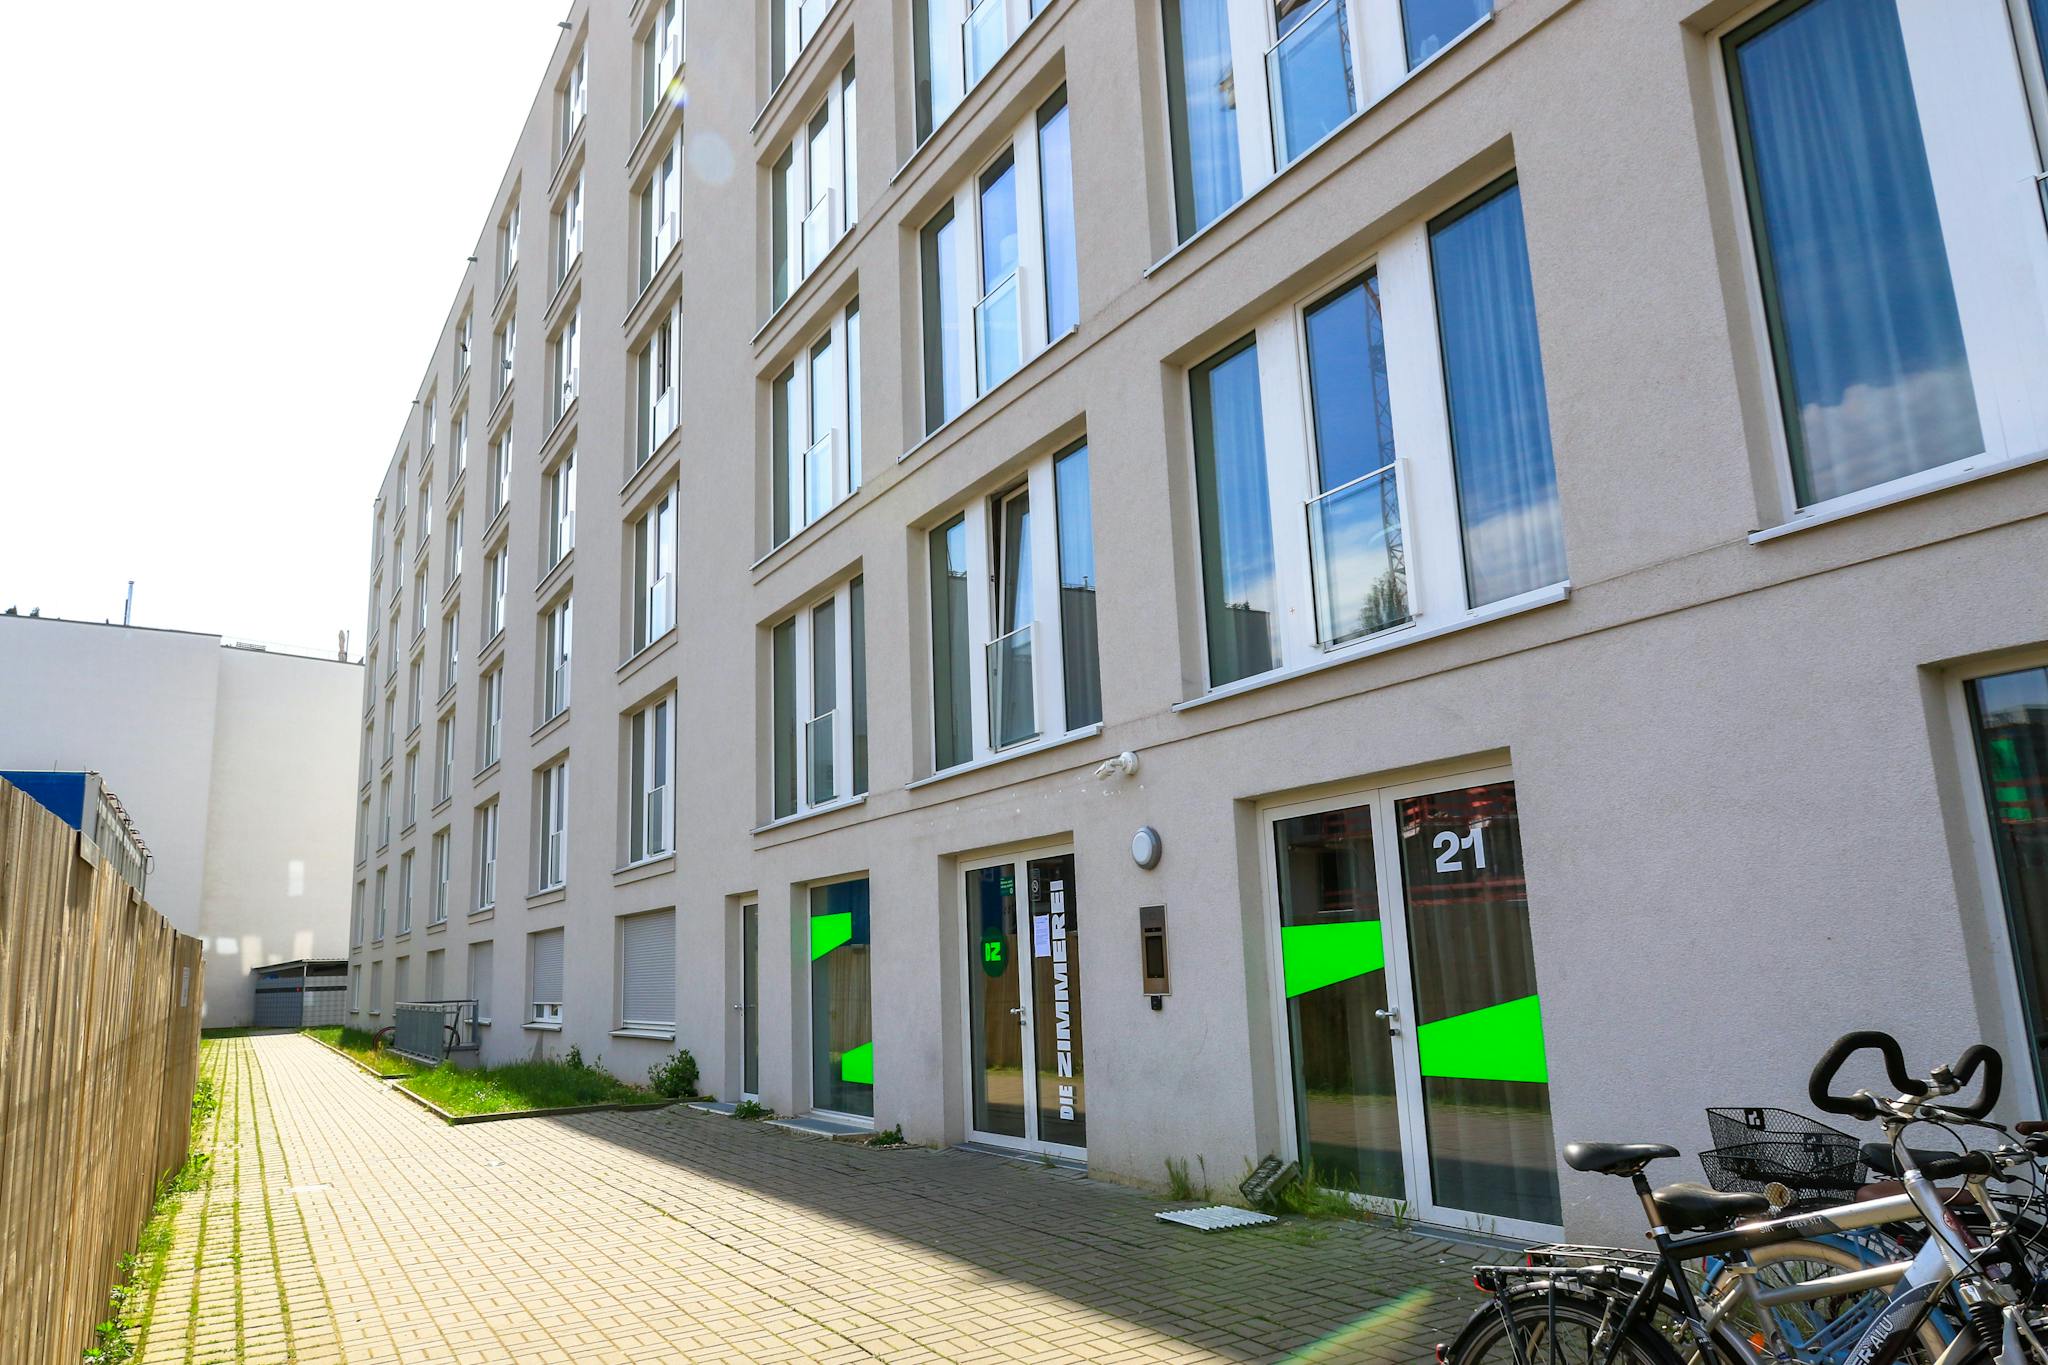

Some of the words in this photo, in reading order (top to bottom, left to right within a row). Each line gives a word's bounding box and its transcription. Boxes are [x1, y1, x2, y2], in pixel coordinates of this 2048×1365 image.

[1433, 827, 1485, 873] 21
[1050, 880, 1073, 1077] ZIMMEREI
[1059, 1085, 1075, 1121] DIE
[1869, 1314, 1894, 1350] ALU
